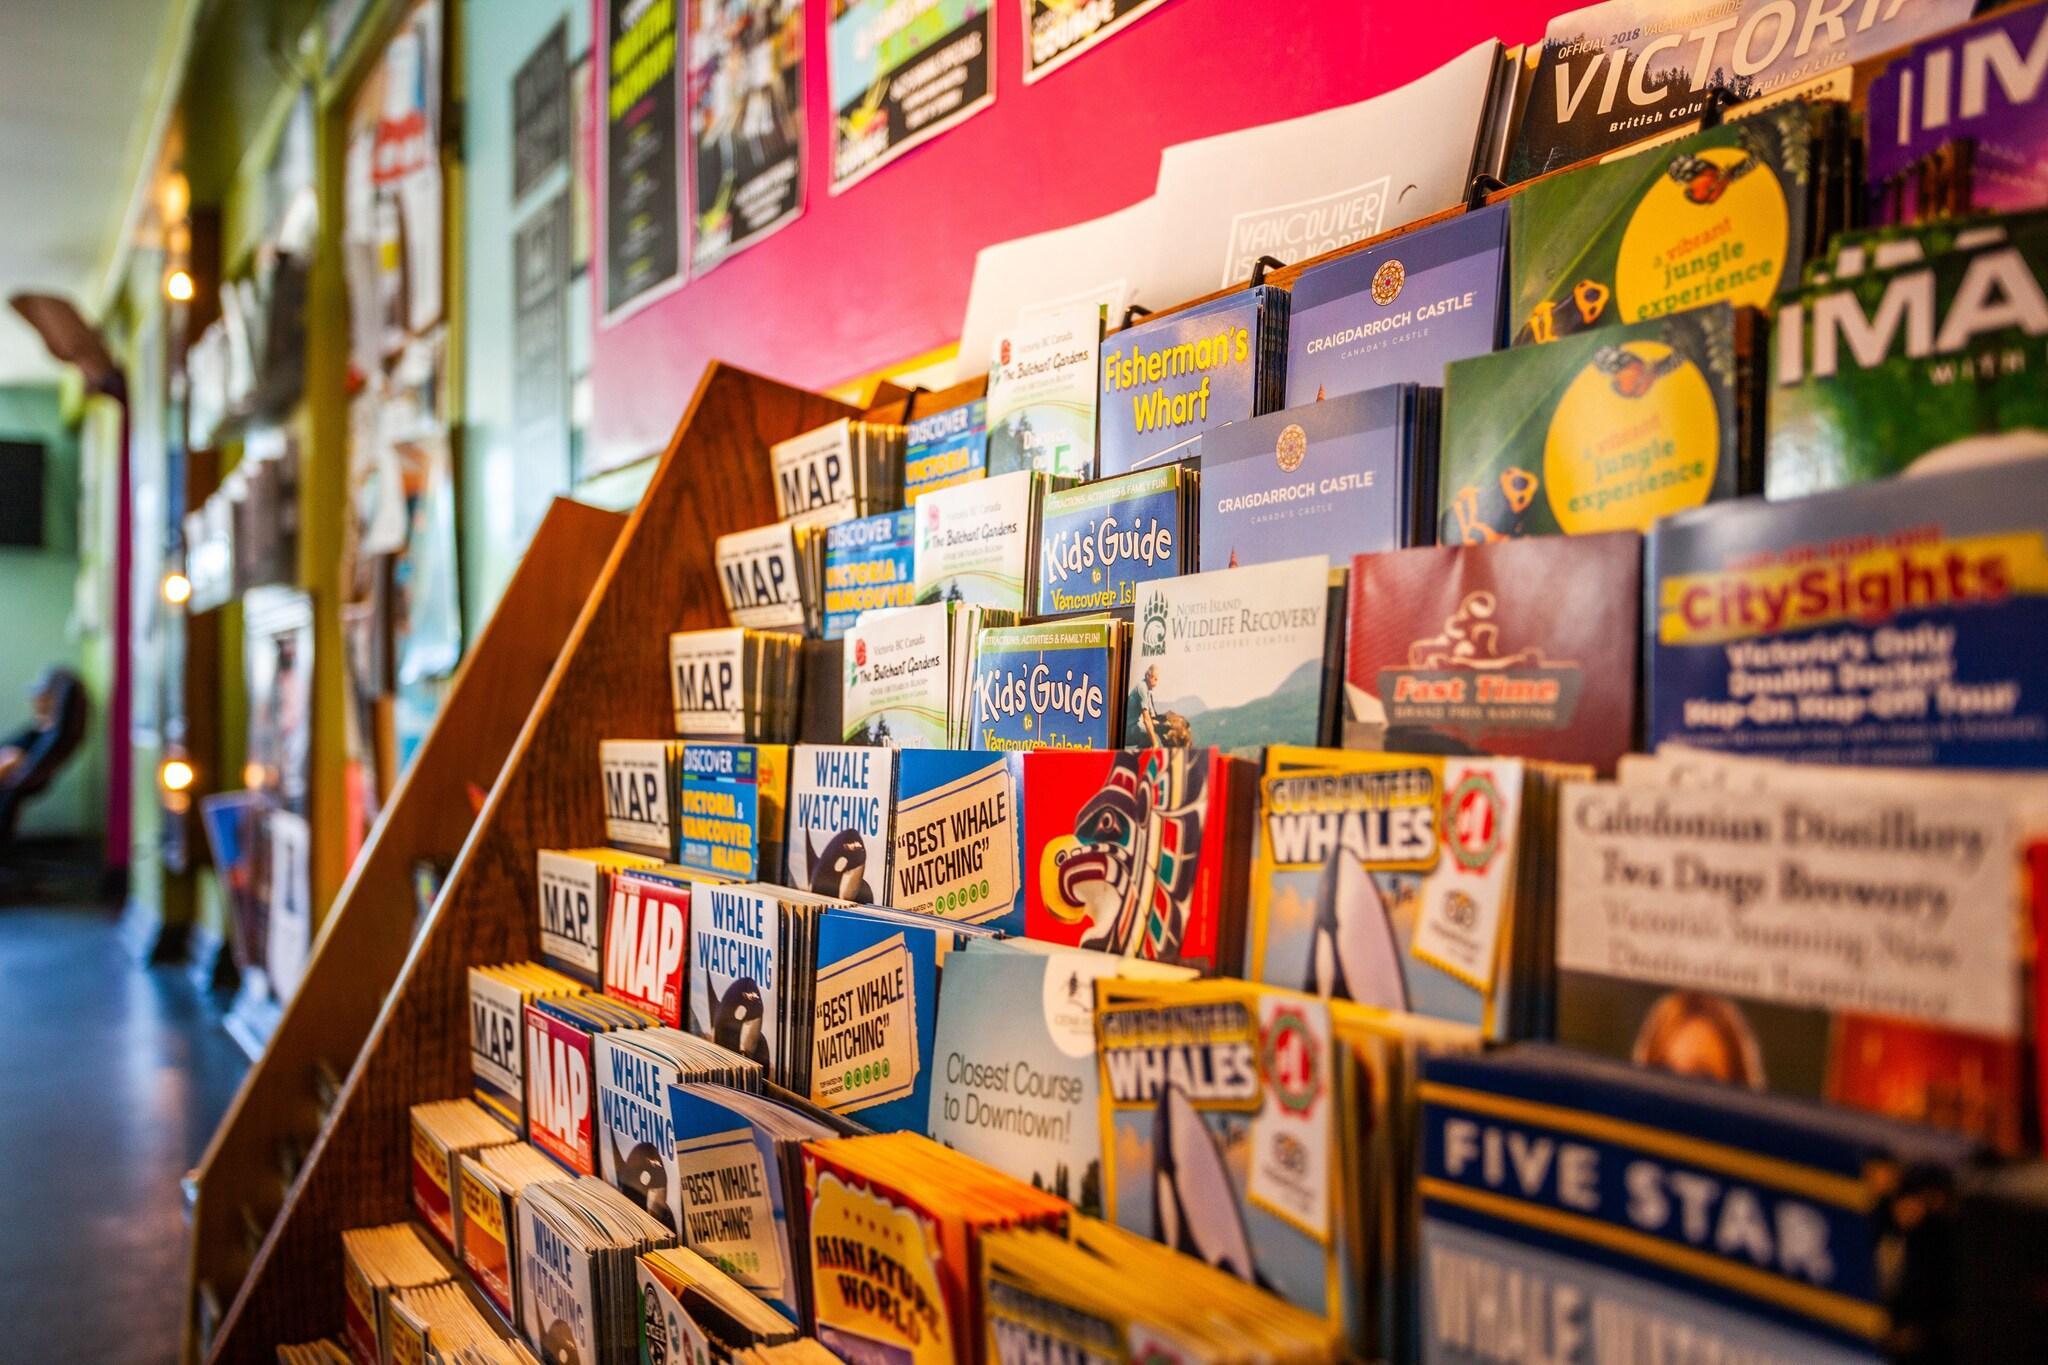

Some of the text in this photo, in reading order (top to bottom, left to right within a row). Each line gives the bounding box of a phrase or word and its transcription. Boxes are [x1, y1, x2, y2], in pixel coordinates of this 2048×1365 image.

[1557, 39, 1608, 60] OFFICIAL
[1609, 28, 1641, 47] 2018
[1641, 13, 1704, 38] VACATION
[1791, 64, 1808, 81] of
[1608, 111, 1664, 134] British
[1239, 192, 1380, 253] VANCOUVER
[1666, 217, 1732, 261] vibrant
[1636, 258, 1773, 321] experience
[1664, 241, 1745, 290] jungle
[1306, 311, 1412, 355] CRAIGDARROCH
[1340, 328, 1430, 361] CANADA'S CASTLE
[1053, 349, 1089, 372] Gardens
[1104, 325, 1249, 394] Fisherman's
[907, 406, 969, 447] DISCOVER
[1132, 375, 1210, 433] Wharf
[781, 454, 842, 518] MAP
[1217, 482, 1316, 514] CRAIGDARROCH
[827, 518, 892, 549] DISCOVER
[981, 521, 1017, 544] Gardens
[1044, 519, 1096, 584] Kids'
[1096, 517, 1173, 567] Guide
[724, 554, 785, 609] MAP
[825, 557, 896, 588] VICTORIA
[1050, 580, 1136, 612] Vancouver Isl
[1091, 568, 1102, 583] to
[1680, 550, 2009, 633] CitySights
[1171, 606, 1321, 640] WILDLIFE RECOVERY
[1176, 598, 1242, 617] NORTH ISLAND
[1021, 634, 1054, 645] ACTIVITIES
[1060, 633, 1084, 644] FAMILY
[1084, 632, 1101, 643] FUN!
[677, 661, 733, 711] MAP
[859, 669, 872, 682] The
[906, 655, 941, 677] Gardens
[974, 663, 1028, 723] Kids'
[1029, 663, 1103, 723] Guide
[1392, 673, 1561, 704] Fast Time
[1024, 714, 1033, 731] to
[683, 747, 734, 774] DISCOVER
[815, 750, 870, 790] WHALE
[605, 771, 658, 824] MAP
[682, 789, 744, 820] VICTORIA &
[797, 792, 880, 837] WATCHING
[1267, 768, 1434, 814] GUARANTEED
[681, 815, 752, 849] VANCOUVER
[897, 790, 1007, 861] “BEST WHALE
[1268, 807, 1436, 864] WHALES
[1574, 799, 1987, 866] Caledonian Distillery
[710, 844, 753, 875] ISLAND
[899, 836, 990, 898] WATCHING”
[543, 882, 590, 944] MAP
[710, 890, 764, 940] WHALE
[1778, 862, 1951, 917] Brewery
[606, 890, 684, 1006] MAP
[697, 930, 773, 991] WATCHING
[816, 966, 905, 1032] “BEST WHALE
[473, 1001, 515, 1071] MAP
[817, 1012, 890, 1070] WATCHING”
[527, 1025, 590, 1152] MAP
[610, 1046, 662, 1108] WHALE
[946, 1051, 1084, 1105] Closest Course
[1106, 1043, 1256, 1101] WHALES
[600, 1085, 675, 1162] WATCHING
[943, 1091, 1072, 1145] to Downtown!
[717, 1163, 762, 1202] WHALE
[1441, 1117, 1602, 1210] FIVE
[1623, 1161, 1838, 1284] STAR
[688, 1206, 753, 1244] WATCHING”
[531, 1213, 573, 1290] WHALE
[526, 1250, 586, 1349] WATCHING
[815, 1235, 942, 1344] MINIATURE
[837, 1273, 922, 1346] WORLD
